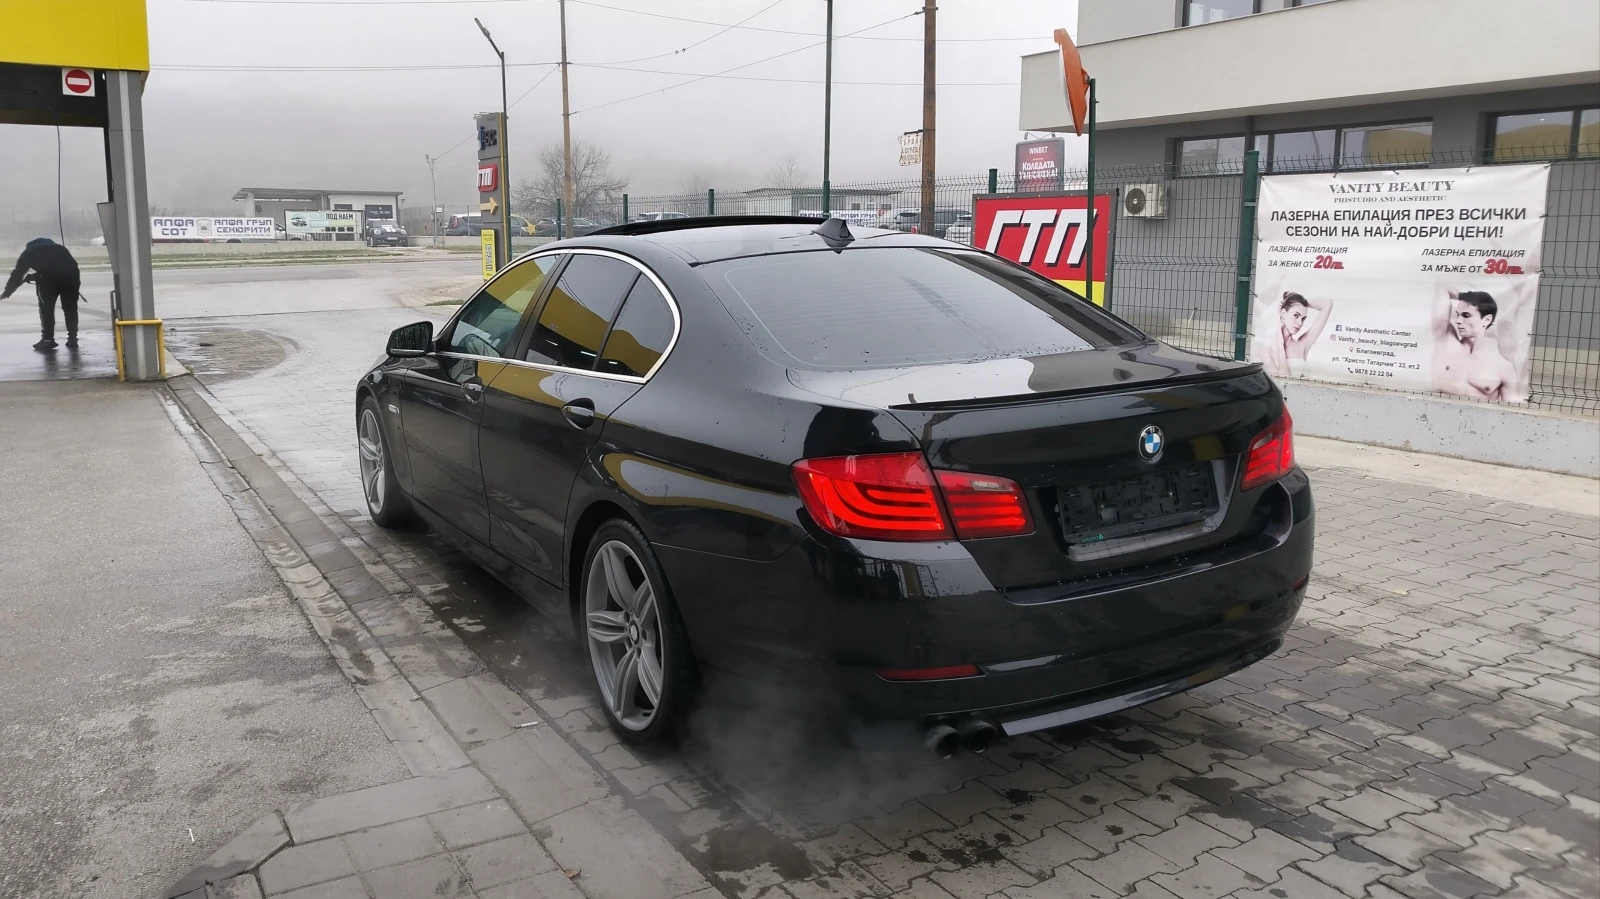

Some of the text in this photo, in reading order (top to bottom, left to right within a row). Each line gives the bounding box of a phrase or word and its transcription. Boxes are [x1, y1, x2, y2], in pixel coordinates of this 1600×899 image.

[1329, 180, 1454, 194] VANITY BEAUTY
[1270, 208, 1526, 223] ЛАЗЕРНА ЕПИЛАЦИЯ ПРЕЗ ВСИЧКИ
[161, 228, 188, 236] СОТ
[985, 209, 1098, 265] ГТП
[1285, 223, 1504, 240] СЕЗОНИ НА НАЙ-ДОБРИ ЦЕНИ!
[1304, 246, 1348, 255] ЕПИЛАЦИЯ
[1421, 248, 1526, 259] ЛАЗЕРНА ЕПИЛАЦИЯ
[1421, 264, 1433, 272] ЗА
[1435, 265, 1467, 273] МЪЖЕ
[1468, 265, 1483, 273] ОТ
[1345, 326, 1362, 334] Vanity
[1363, 327, 1390, 335] Aesthetic
